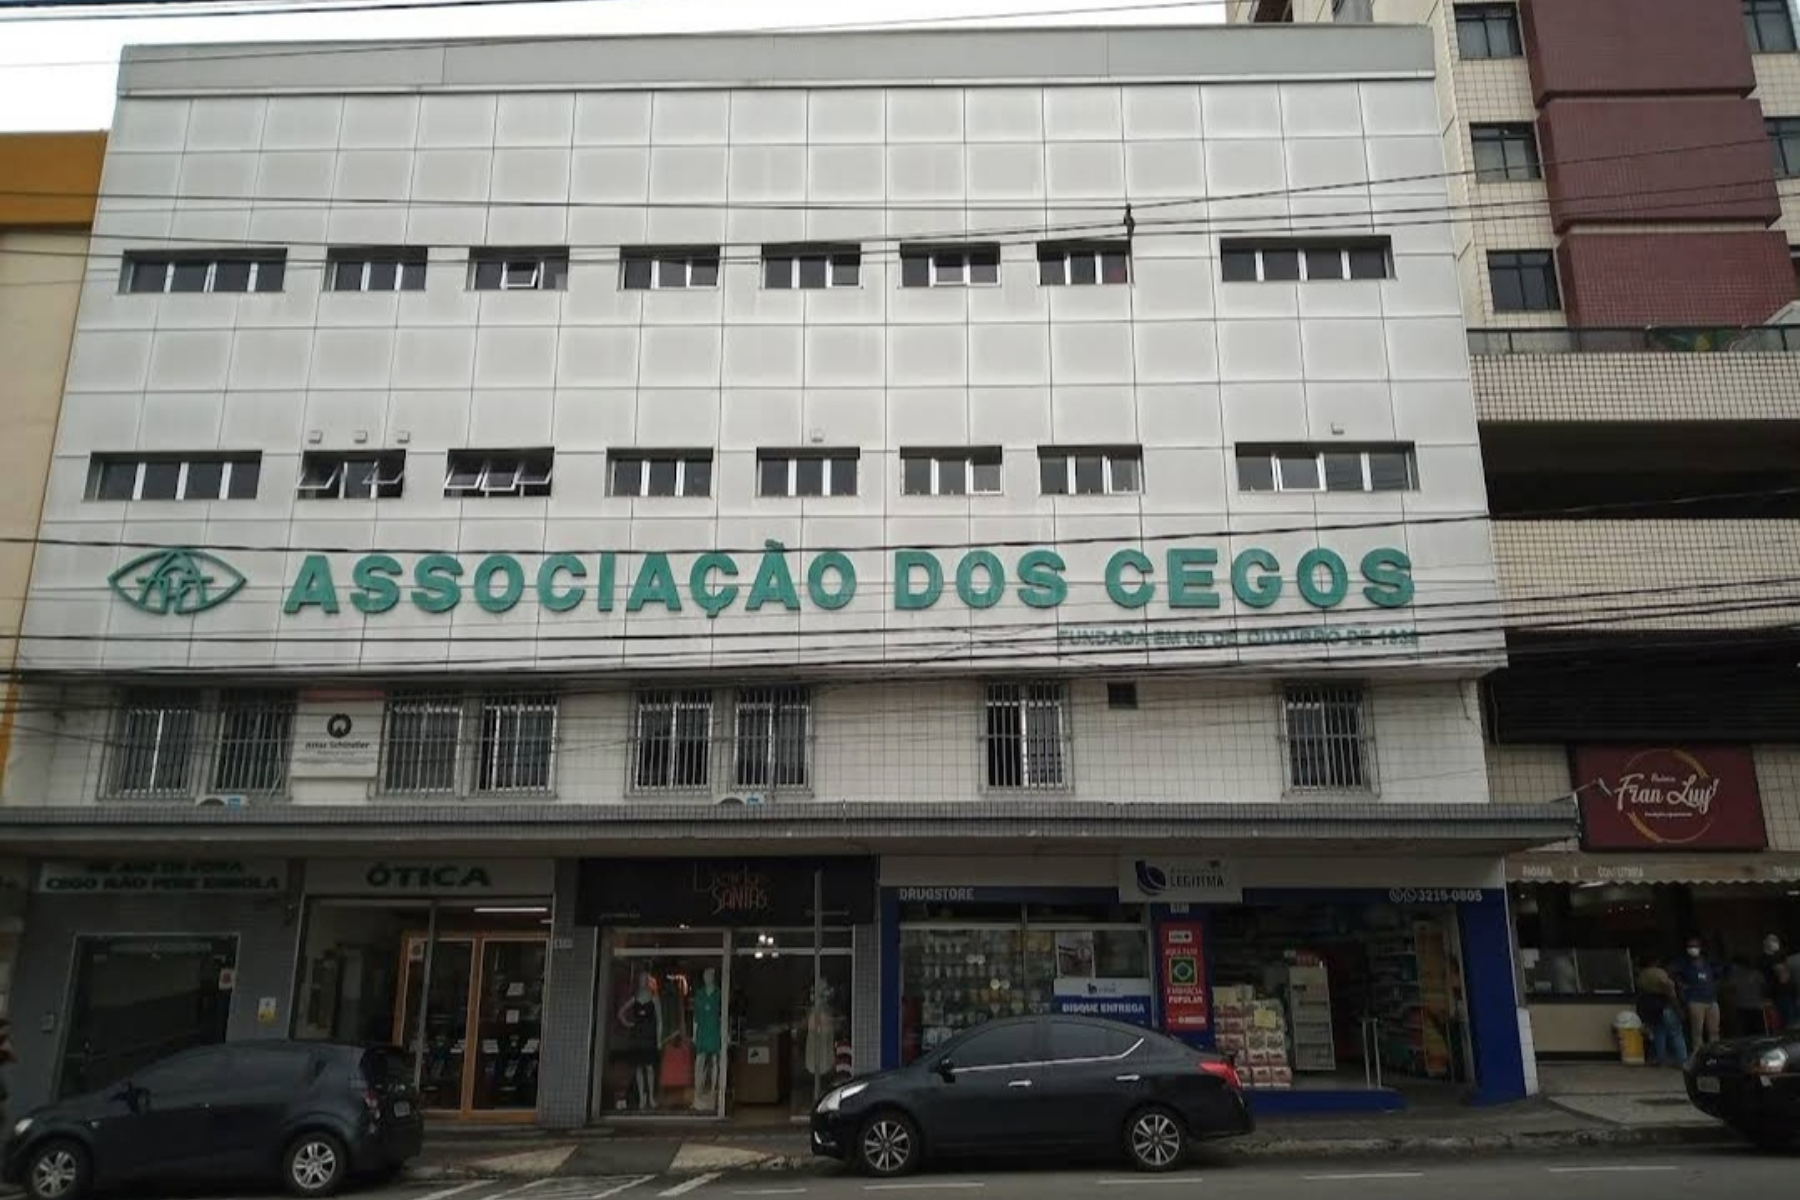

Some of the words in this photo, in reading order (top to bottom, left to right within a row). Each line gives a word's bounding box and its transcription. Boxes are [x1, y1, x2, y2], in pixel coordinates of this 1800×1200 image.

[285, 539, 856, 618] ASSOCIAÇÃO
[894, 549, 1068, 610] DOS
[1105, 548, 1415, 609] CEGOS
[1614, 773, 1662, 812] Fran
[367, 861, 491, 887] ÓTICA
[899, 887, 975, 902] DRUGSTORE
